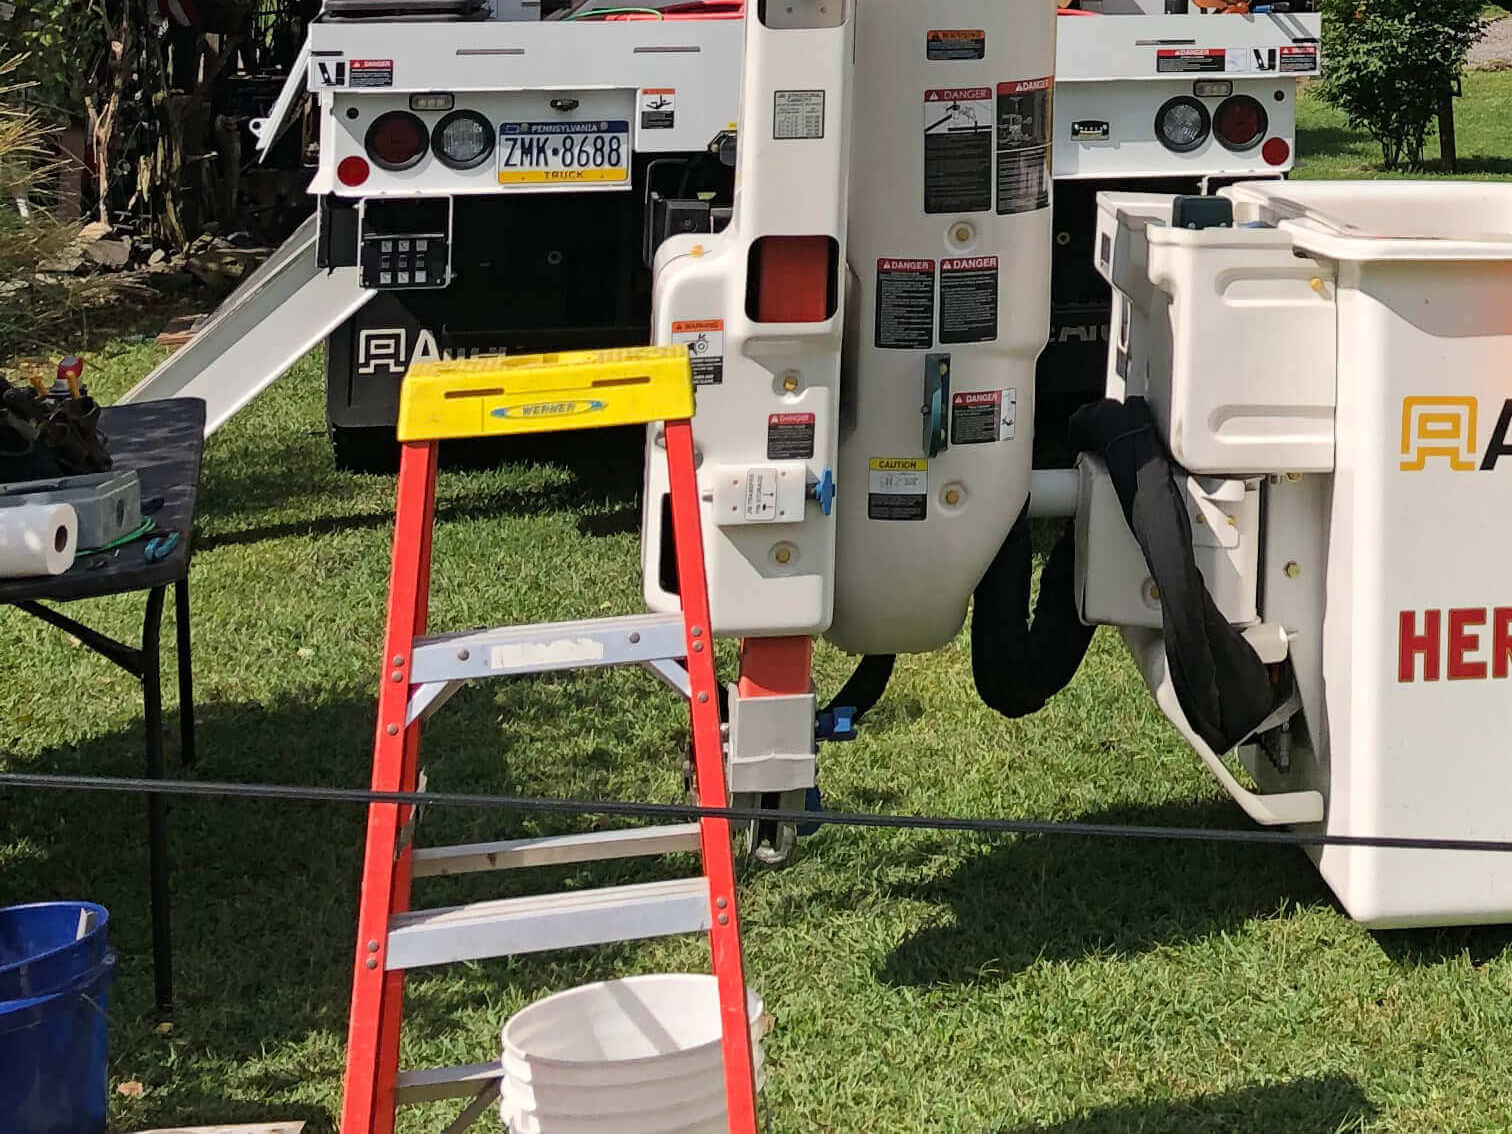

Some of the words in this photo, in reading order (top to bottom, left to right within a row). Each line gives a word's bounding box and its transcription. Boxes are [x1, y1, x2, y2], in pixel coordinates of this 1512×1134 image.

[943, 89, 987, 100] DANGER
[531, 124, 598, 133] PENNSYLVANIA
[543, 170, 585, 179] TRUCK
[891, 261, 929, 270] DANGER
[953, 258, 997, 270] DANGER
[966, 394, 998, 404] DANGER
[521, 402, 577, 417] WERNER
[878, 460, 917, 470] CAUTION
